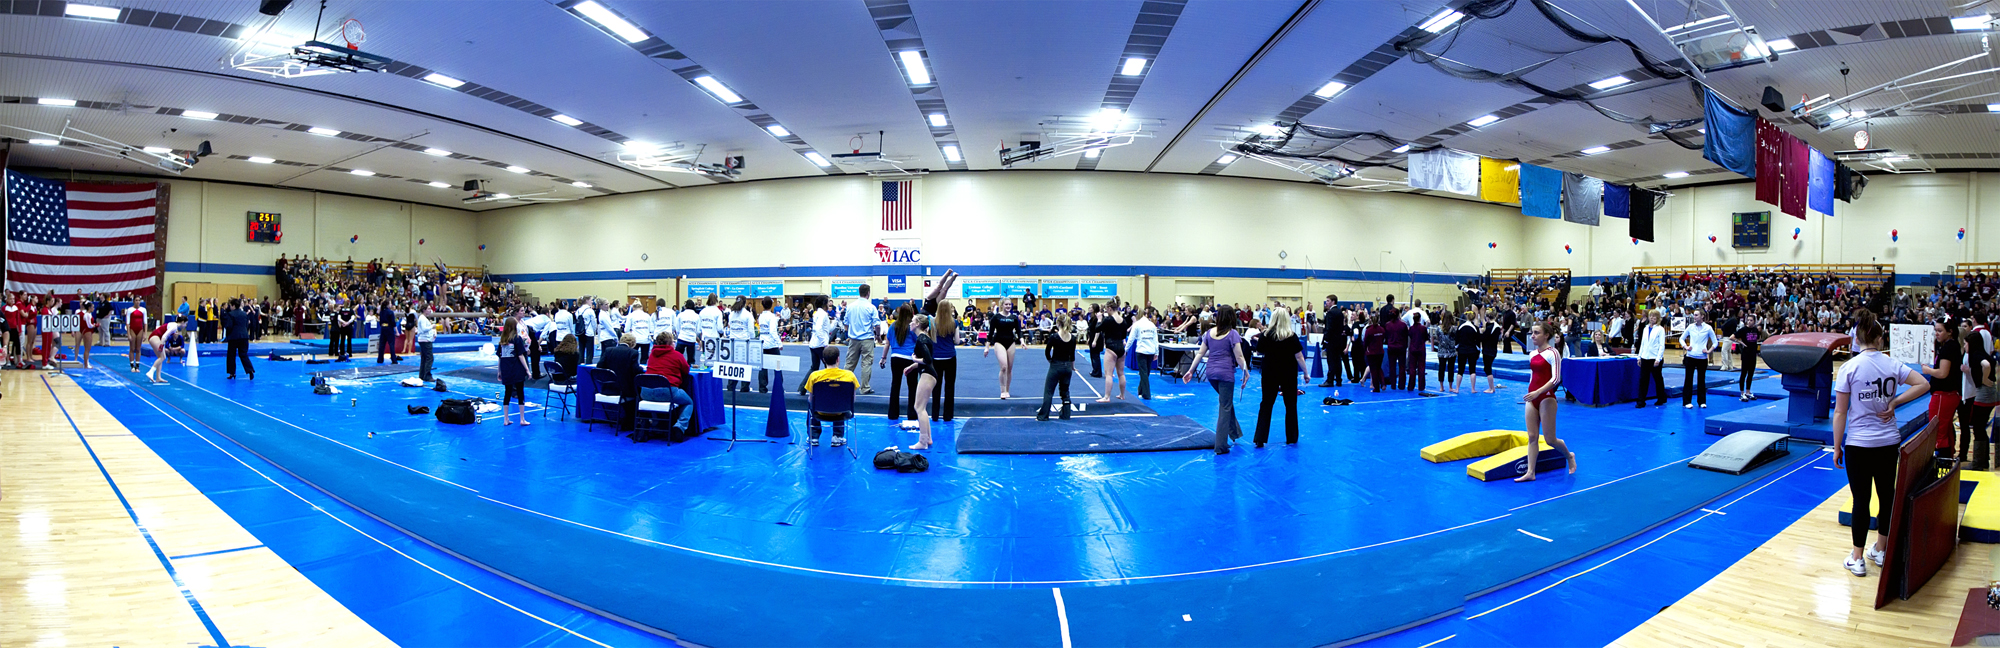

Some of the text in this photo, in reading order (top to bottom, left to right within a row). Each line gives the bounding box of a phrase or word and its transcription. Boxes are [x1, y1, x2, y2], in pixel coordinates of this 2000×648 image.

[250, 222, 259, 230] 20
[250, 231, 254, 240] 0
[879, 249, 921, 263] WIAC
[718, 364, 746, 379] FLOOR
[1872, 376, 1896, 398] 10
